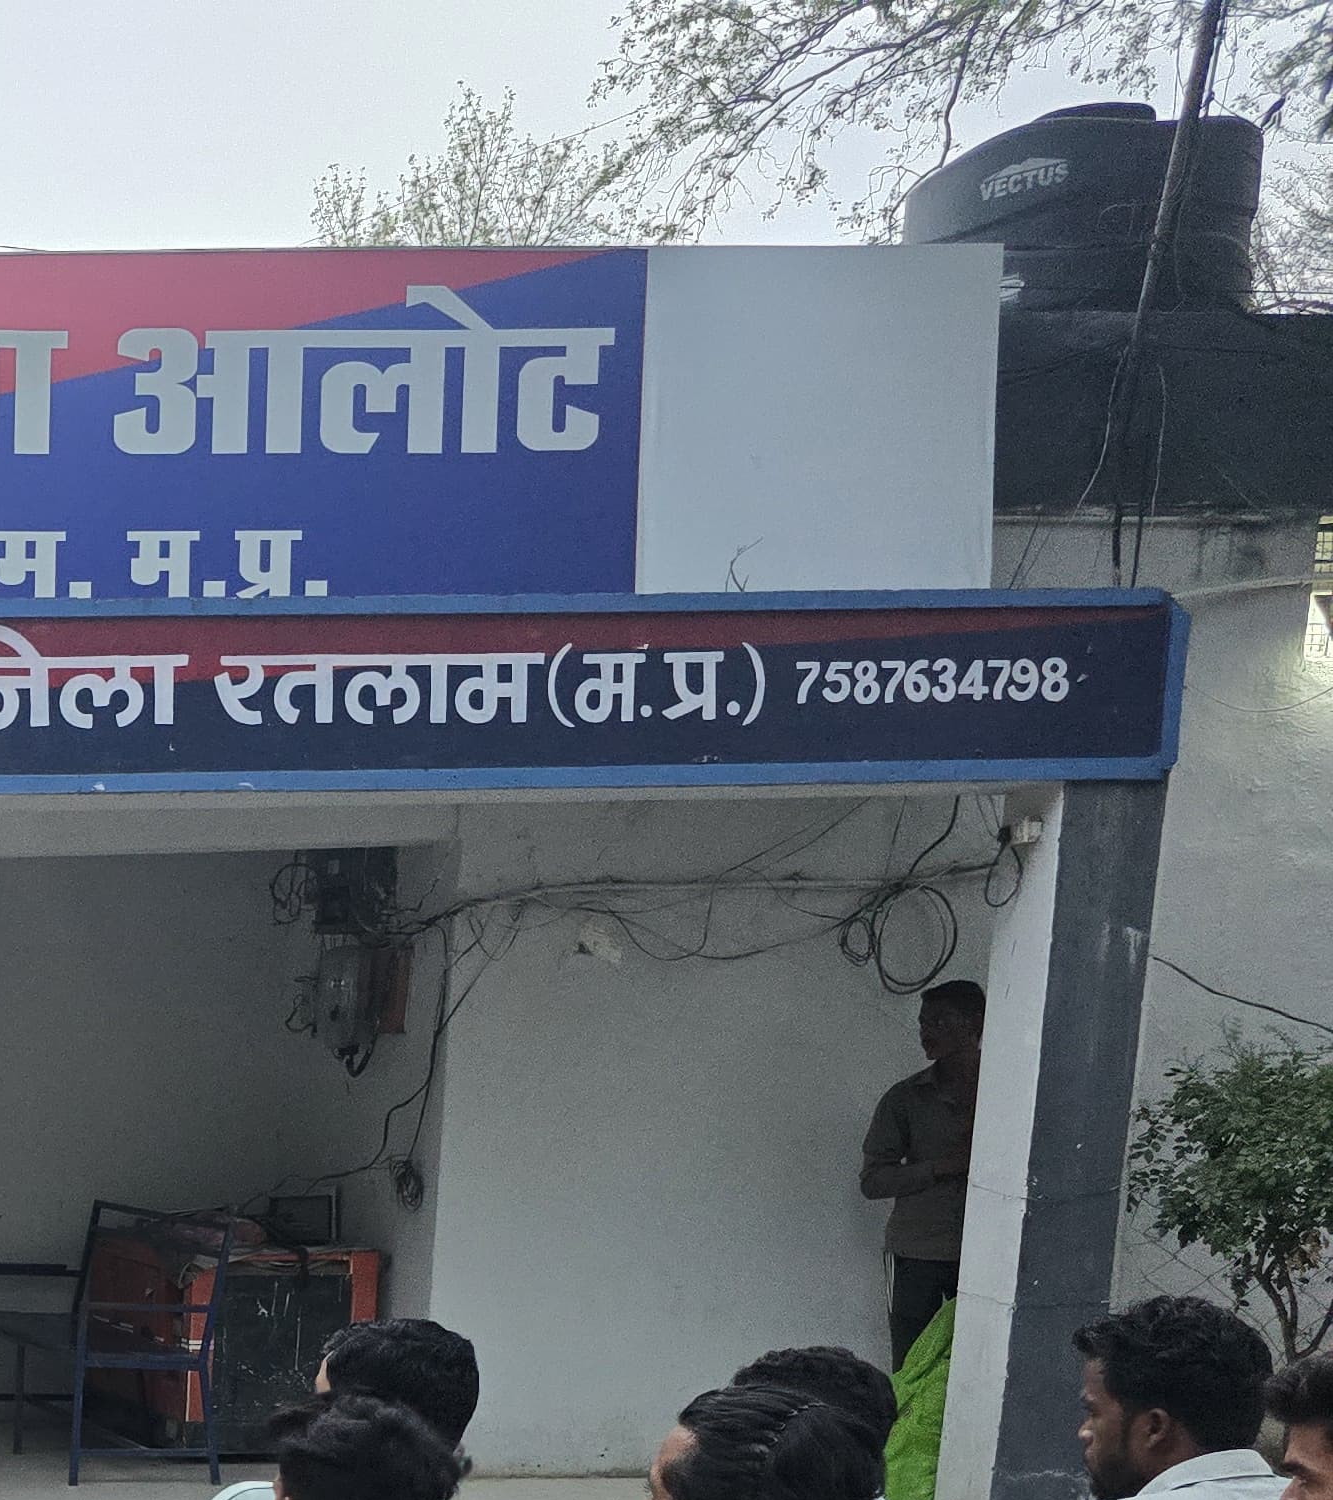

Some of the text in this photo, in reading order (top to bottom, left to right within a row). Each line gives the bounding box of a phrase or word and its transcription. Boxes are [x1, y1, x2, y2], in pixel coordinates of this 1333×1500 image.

[980, 163, 1069, 201] VECTUS
[114, 286, 615, 454] आलोट
[795, 657, 1069, 706] 7587634798
